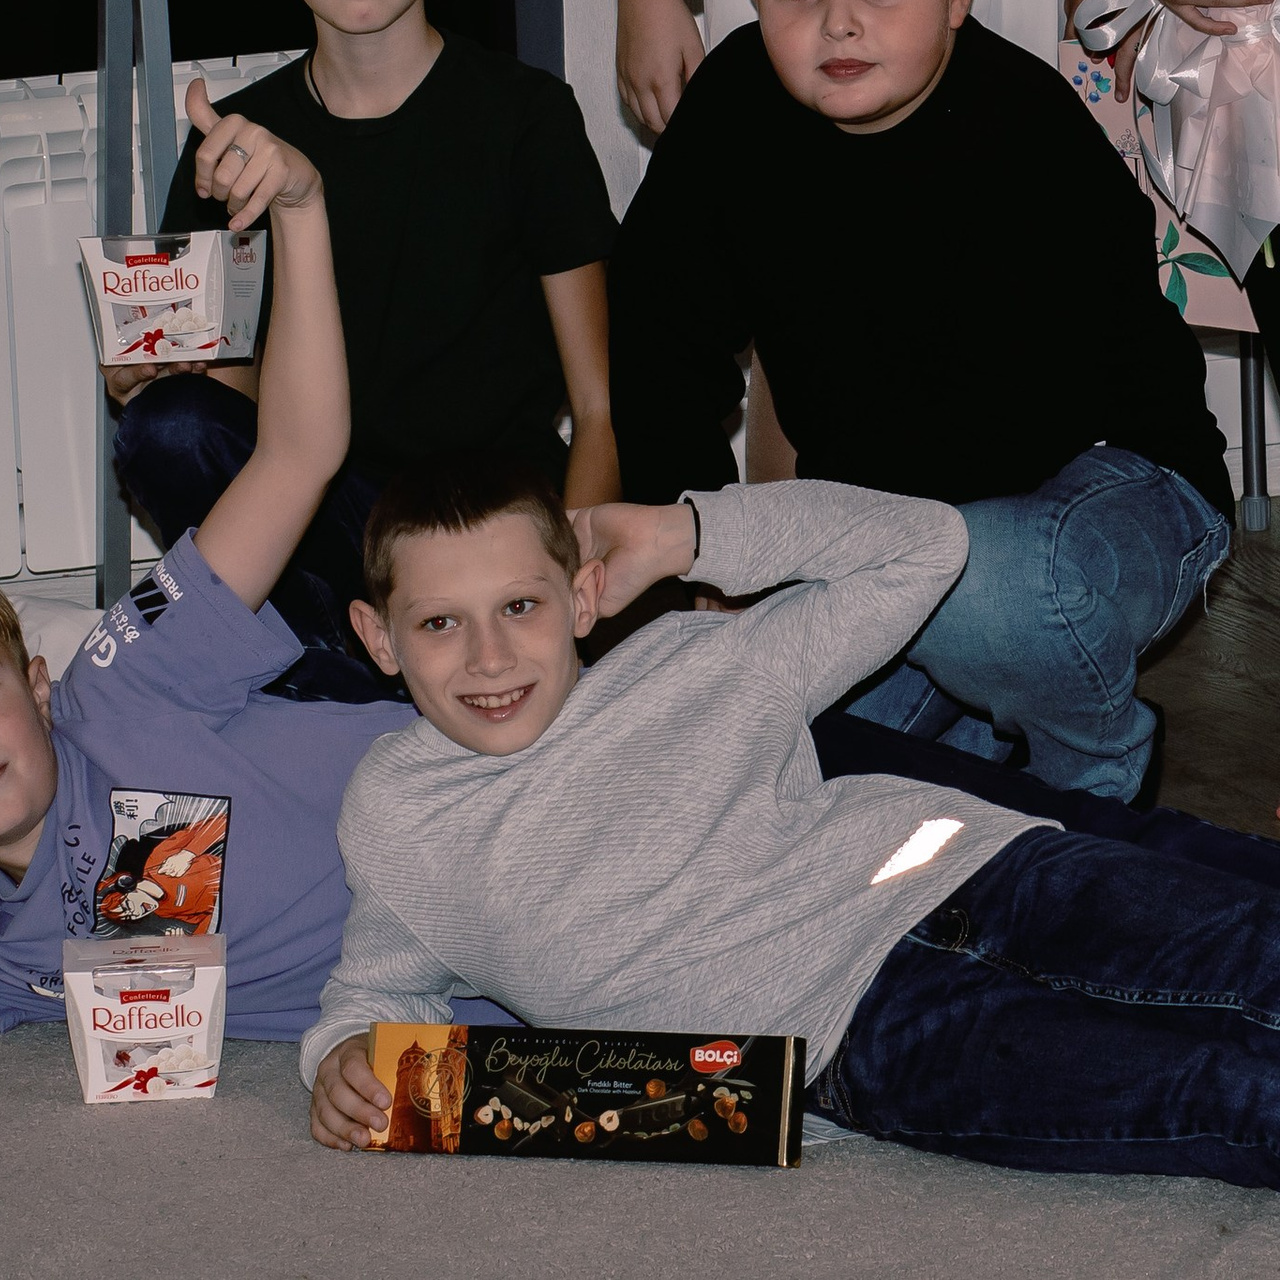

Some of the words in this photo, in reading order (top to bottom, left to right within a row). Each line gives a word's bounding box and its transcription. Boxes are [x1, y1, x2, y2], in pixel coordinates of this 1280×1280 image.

[103, 268, 200, 297] Raffaello
[92, 1004, 203, 1034] Raffaello
[485, 1037, 574, 1084] Beyoğlu
